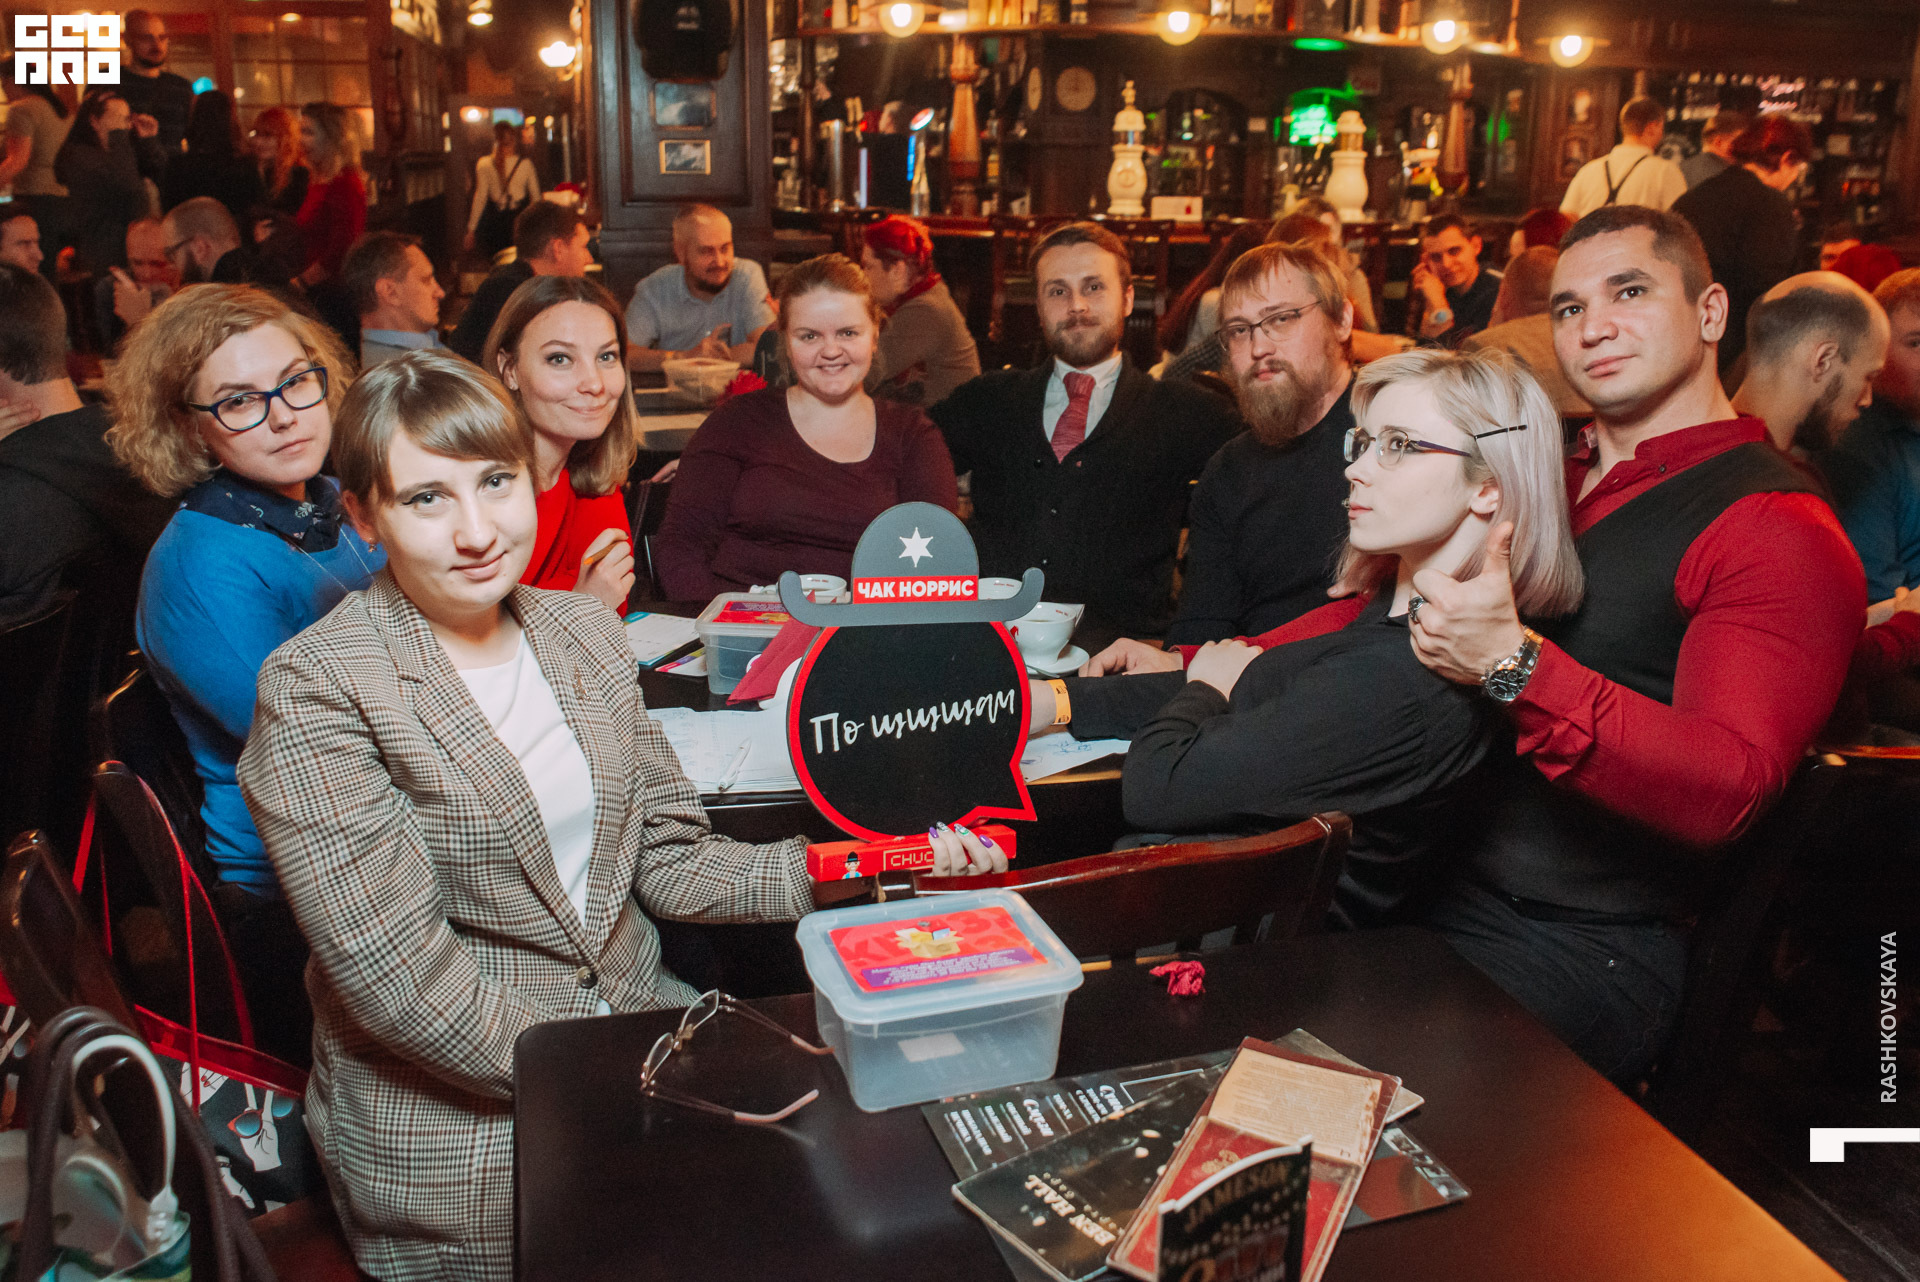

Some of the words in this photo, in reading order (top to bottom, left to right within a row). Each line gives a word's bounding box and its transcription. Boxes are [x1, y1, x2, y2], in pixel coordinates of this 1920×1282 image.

[858, 581, 896, 598] ЧАК
[899, 579, 975, 598] НОРРИС
[810, 712, 865, 754] По
[890, 851, 934, 867] CHUC
[1024, 1174, 1076, 1217] HALL
[1068, 1213, 1117, 1247] BEN
